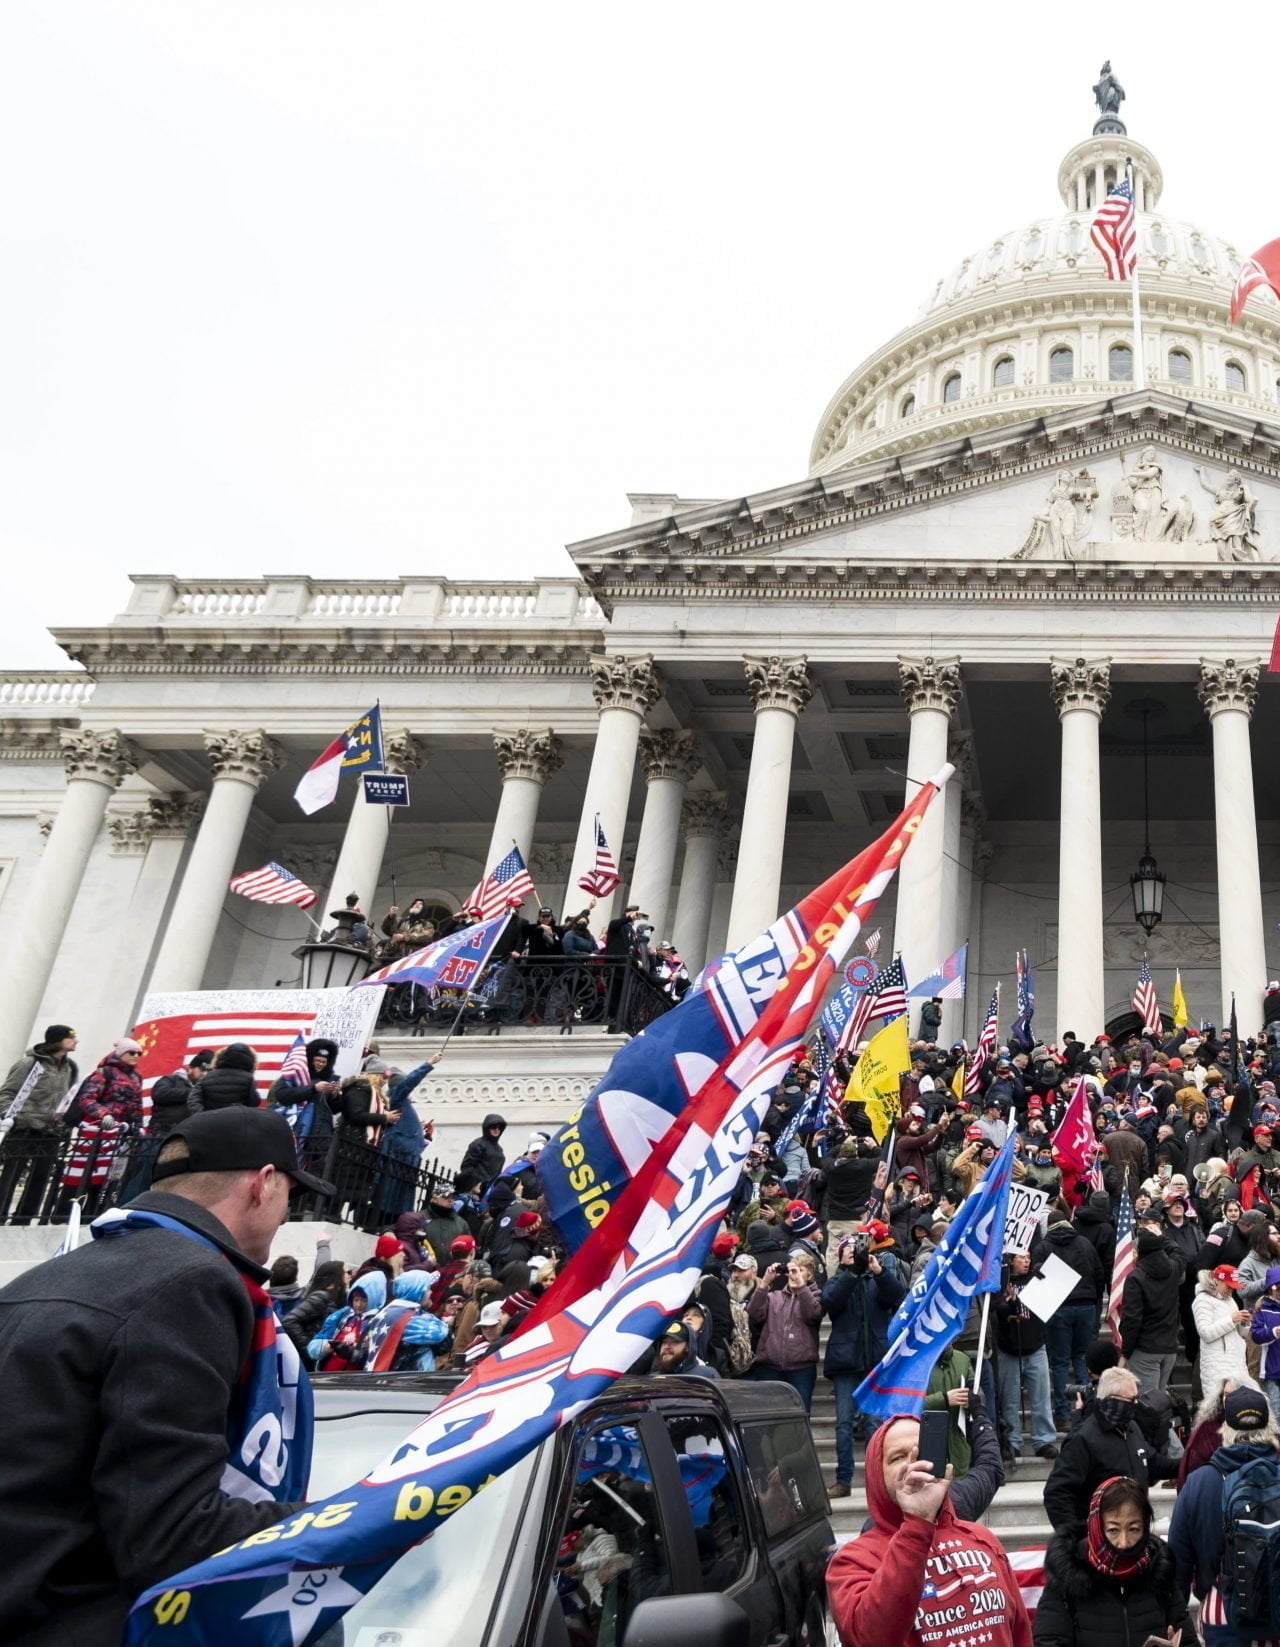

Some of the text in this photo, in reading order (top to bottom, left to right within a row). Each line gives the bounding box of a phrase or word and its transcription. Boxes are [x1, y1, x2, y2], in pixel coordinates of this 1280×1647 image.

[366, 781, 405, 790] TRUMP
[315, 1020, 358, 1029] MASTERS
[1009, 1187, 1042, 1219] TOP
[924, 1549, 992, 1580] rump
[914, 1588, 1006, 1631] Pence 2020
[921, 1631, 943, 1643] KEEP
[946, 1620, 984, 1638] AMERICA
